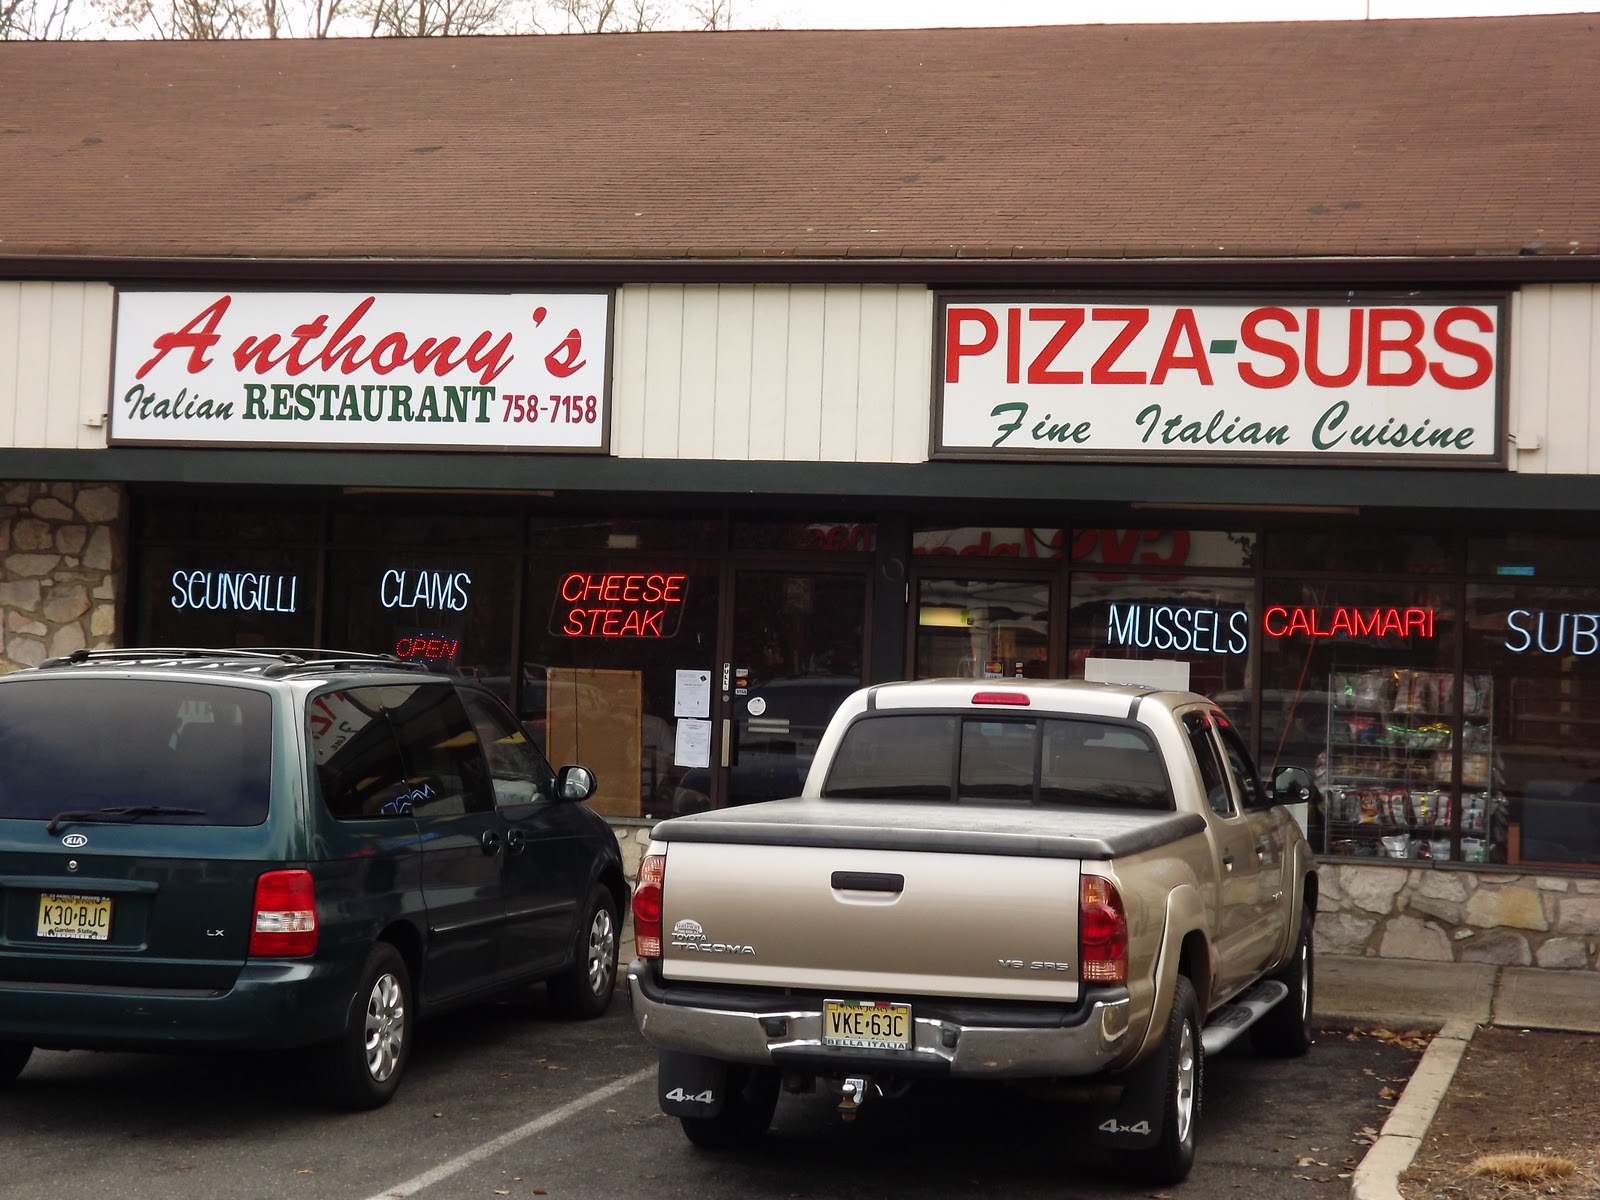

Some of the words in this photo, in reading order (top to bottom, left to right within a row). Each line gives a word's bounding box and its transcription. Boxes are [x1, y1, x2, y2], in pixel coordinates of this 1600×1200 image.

[136, 295, 587, 386] Anthony's
[124, 383, 234, 421] Italian
[242, 383, 496, 423] RESTAURANT
[502, 393, 598, 425] 758-7158
[990, 401, 1091, 448] Fine
[1135, 403, 1291, 446] Italian
[1311, 400, 1474, 451] Cuisine
[380, 569, 472, 611] CLAMS
[562, 573, 685, 603] CHEESE
[562, 608, 665, 637] STEAK
[1107, 603, 1249, 654] MUSSELS
[1263, 606, 1435, 638] CALAMARI
[396, 638, 458, 659] OPEN
[206, 929, 225, 937] LX
[671, 932, 707, 941] TOYOTA
[671, 941, 757, 956] TACOMA
[998, 959, 1024, 968] V6
[864, 1005, 889, 1013] Jersey
[826, 1038, 864, 1047] BELLA
[867, 1040, 906, 1050] ITALIA
[665, 1087, 715, 1104] 4x4
[1098, 1118, 1152, 1136] 4x4
